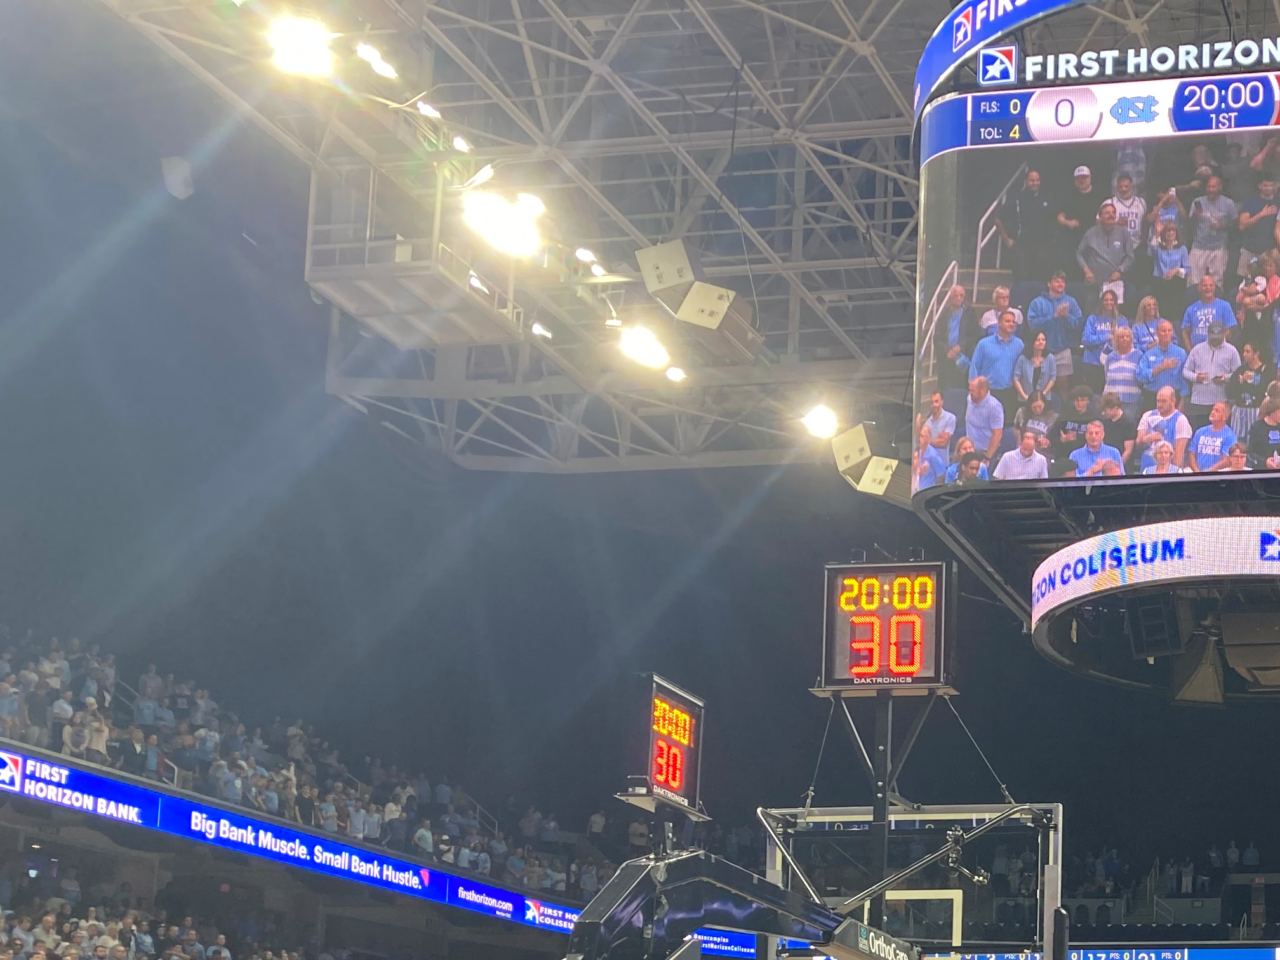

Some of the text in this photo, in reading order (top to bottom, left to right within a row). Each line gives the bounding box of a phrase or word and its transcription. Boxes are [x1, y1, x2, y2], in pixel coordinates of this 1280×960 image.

[1025, 50, 1119, 81] FIRST
[980, 99, 1021, 114] FLS: 0
[1183, 81, 1264, 111] 20:00
[1054, 99, 1075, 127] 0
[1210, 113, 1238, 129] 1ST
[980, 124, 1020, 140] TOL: 4
[1060, 537, 1186, 586] COLISEUM
[839, 575, 934, 611] 20:00
[850, 613, 923, 676] 30
[25, 759, 69, 786] FIRST
[652, 738, 684, 791] 30
[23, 779, 143, 824] HORIZON BANK.
[190, 810, 422, 890] Big Bank Muscle. Small Bank Hustle.
[458, 886, 513, 912] firsthorizon.com
[540, 906, 563, 918] FIRST
[539, 916, 575, 930] COLISEU
